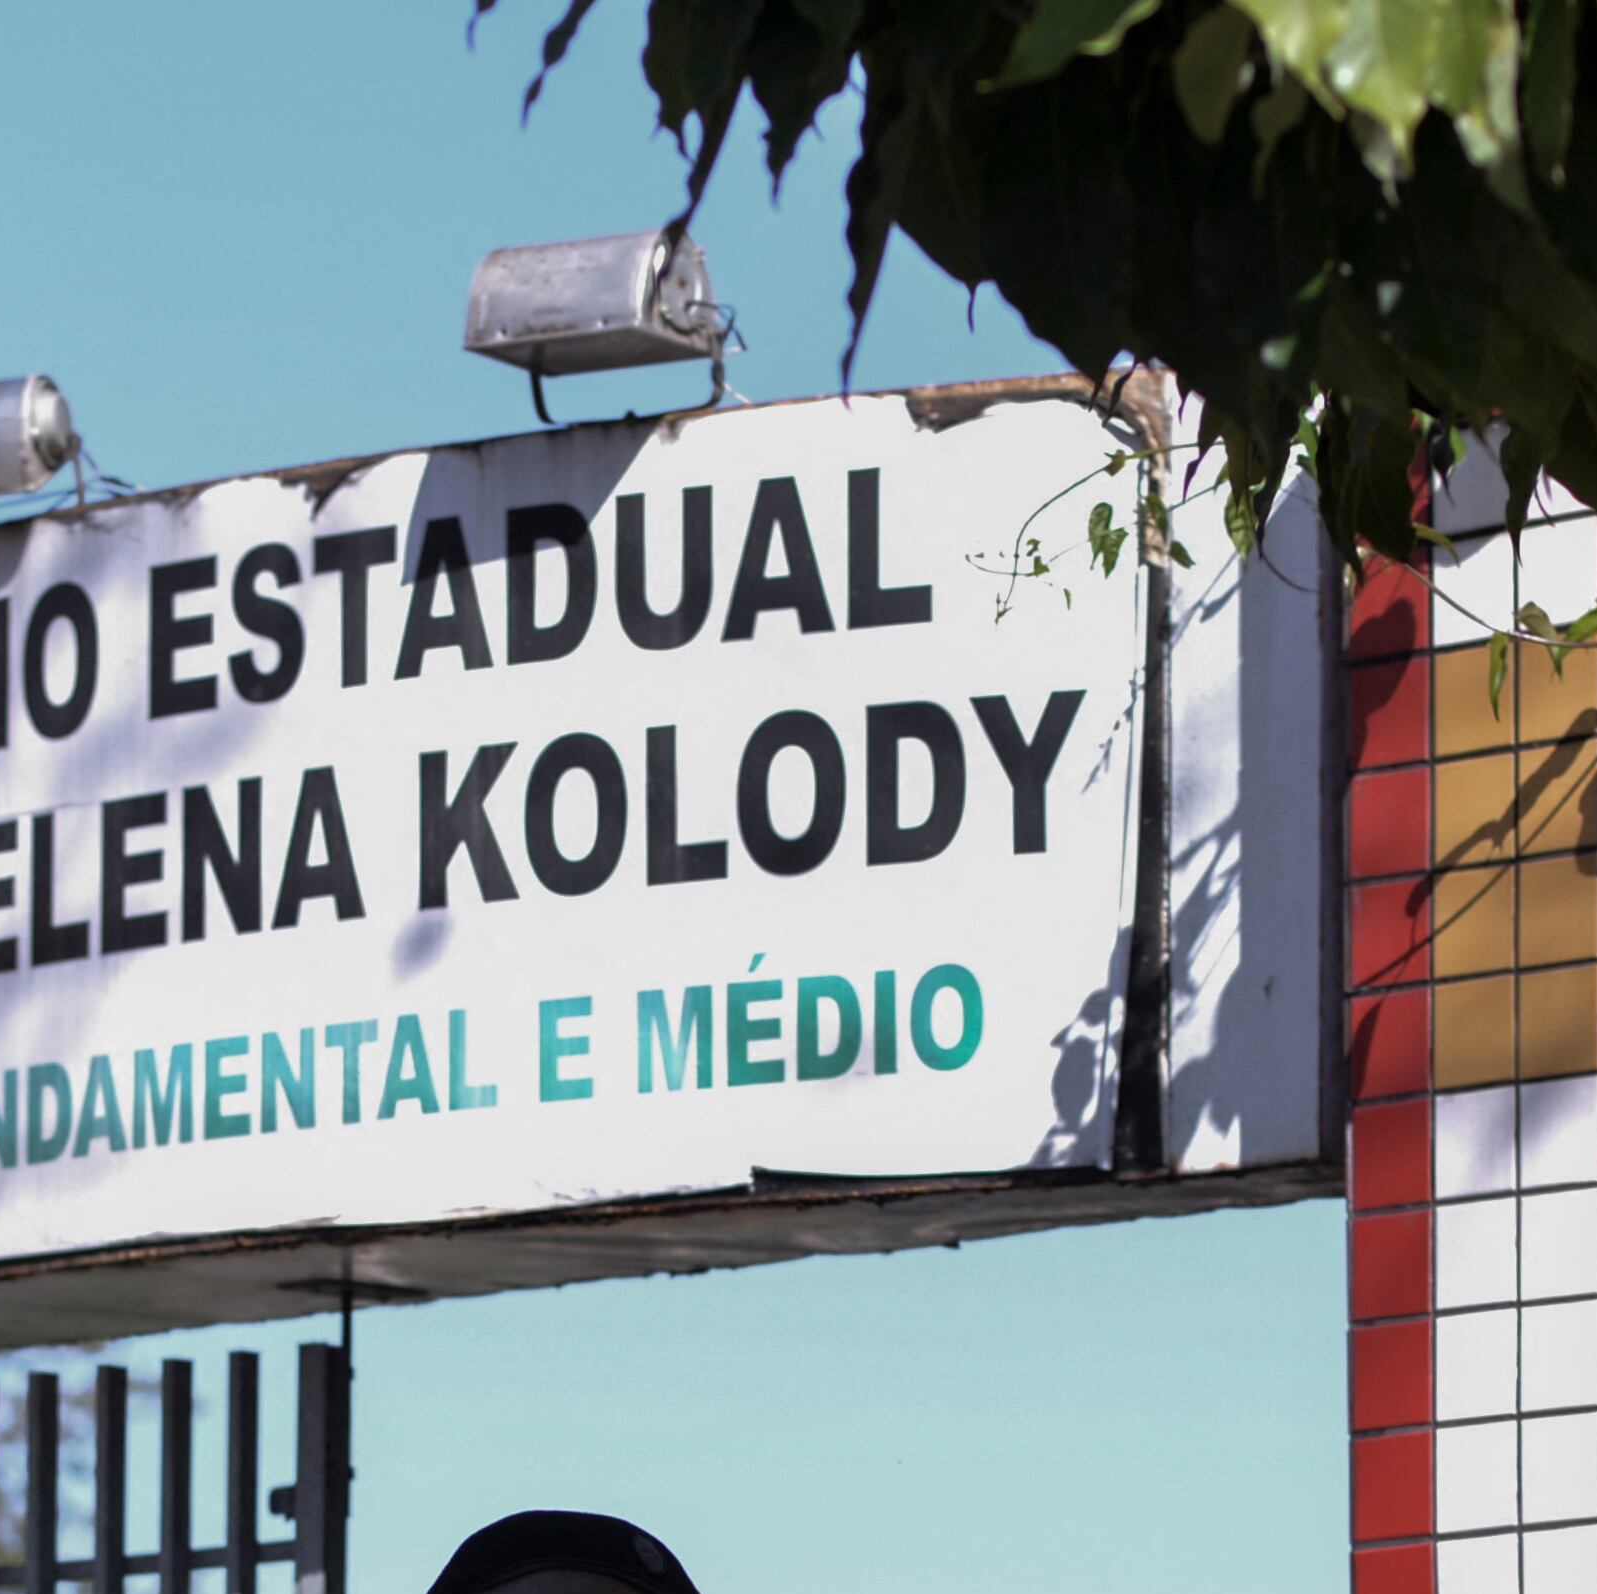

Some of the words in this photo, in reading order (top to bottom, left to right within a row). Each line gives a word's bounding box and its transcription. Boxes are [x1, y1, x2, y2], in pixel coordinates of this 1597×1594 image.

[148, 467, 932, 720] ESTADUAL
[418, 689, 1088, 912] KOLODY
[538, 995, 594, 1103] E
[636, 951, 985, 1095] MÉDIO
